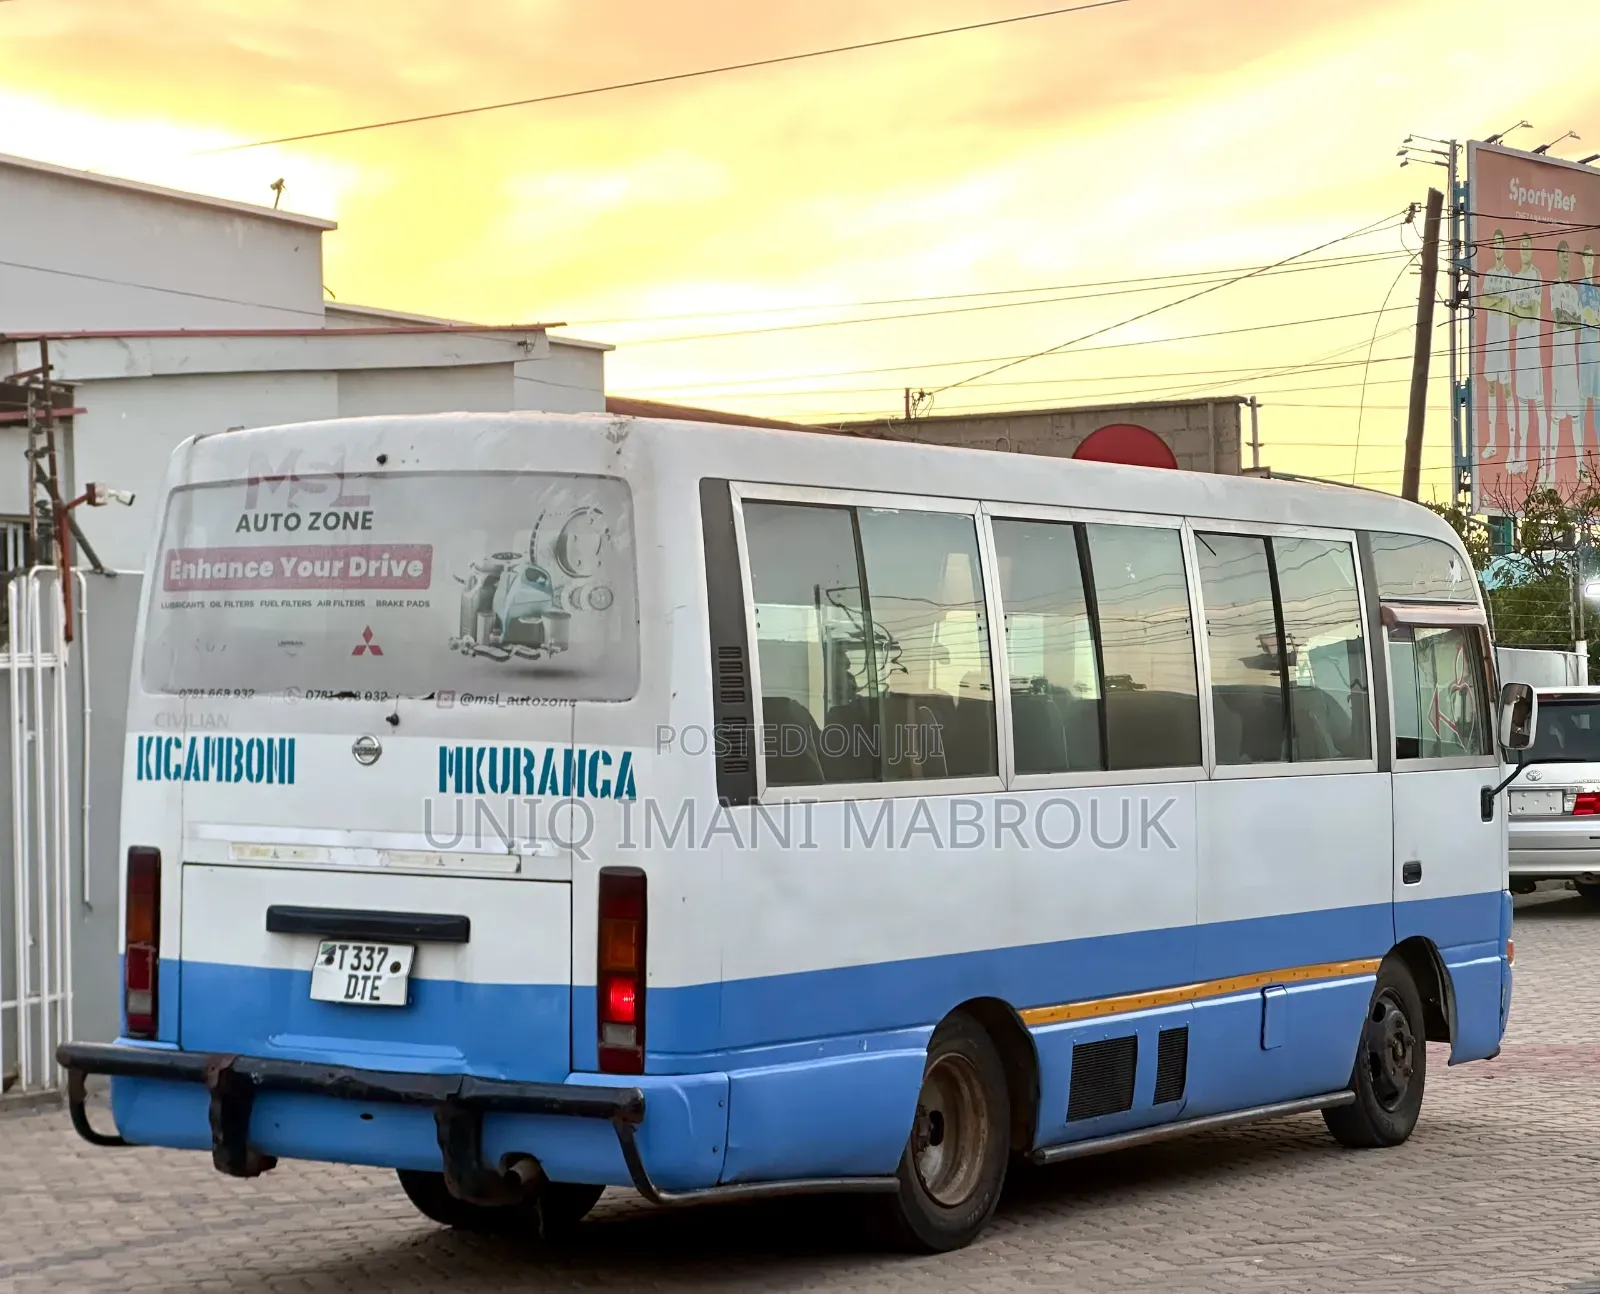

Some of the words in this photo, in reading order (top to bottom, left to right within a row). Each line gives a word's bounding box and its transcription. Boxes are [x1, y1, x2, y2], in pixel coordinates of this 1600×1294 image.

[1509, 177, 1576, 212] SportyBet
[235, 512, 302, 533] AUTO
[308, 511, 374, 531] ZONE
[170, 557, 274, 580] Enhance
[280, 556, 345, 578] Your
[349, 553, 424, 577] Drive
[161, 601, 205, 609] LUBRICANTS
[224, 600, 254, 608] FILTERS
[260, 600, 279, 608] FUEL
[281, 600, 312, 608] FILTERS
[406, 600, 430, 608] PADS
[460, 692, 577, 708] @msl_autozone
[154, 712, 229, 729] CIVILIAN
[137, 736, 295, 784] KIGAMBONI
[439, 746, 637, 800] MKURANGA
